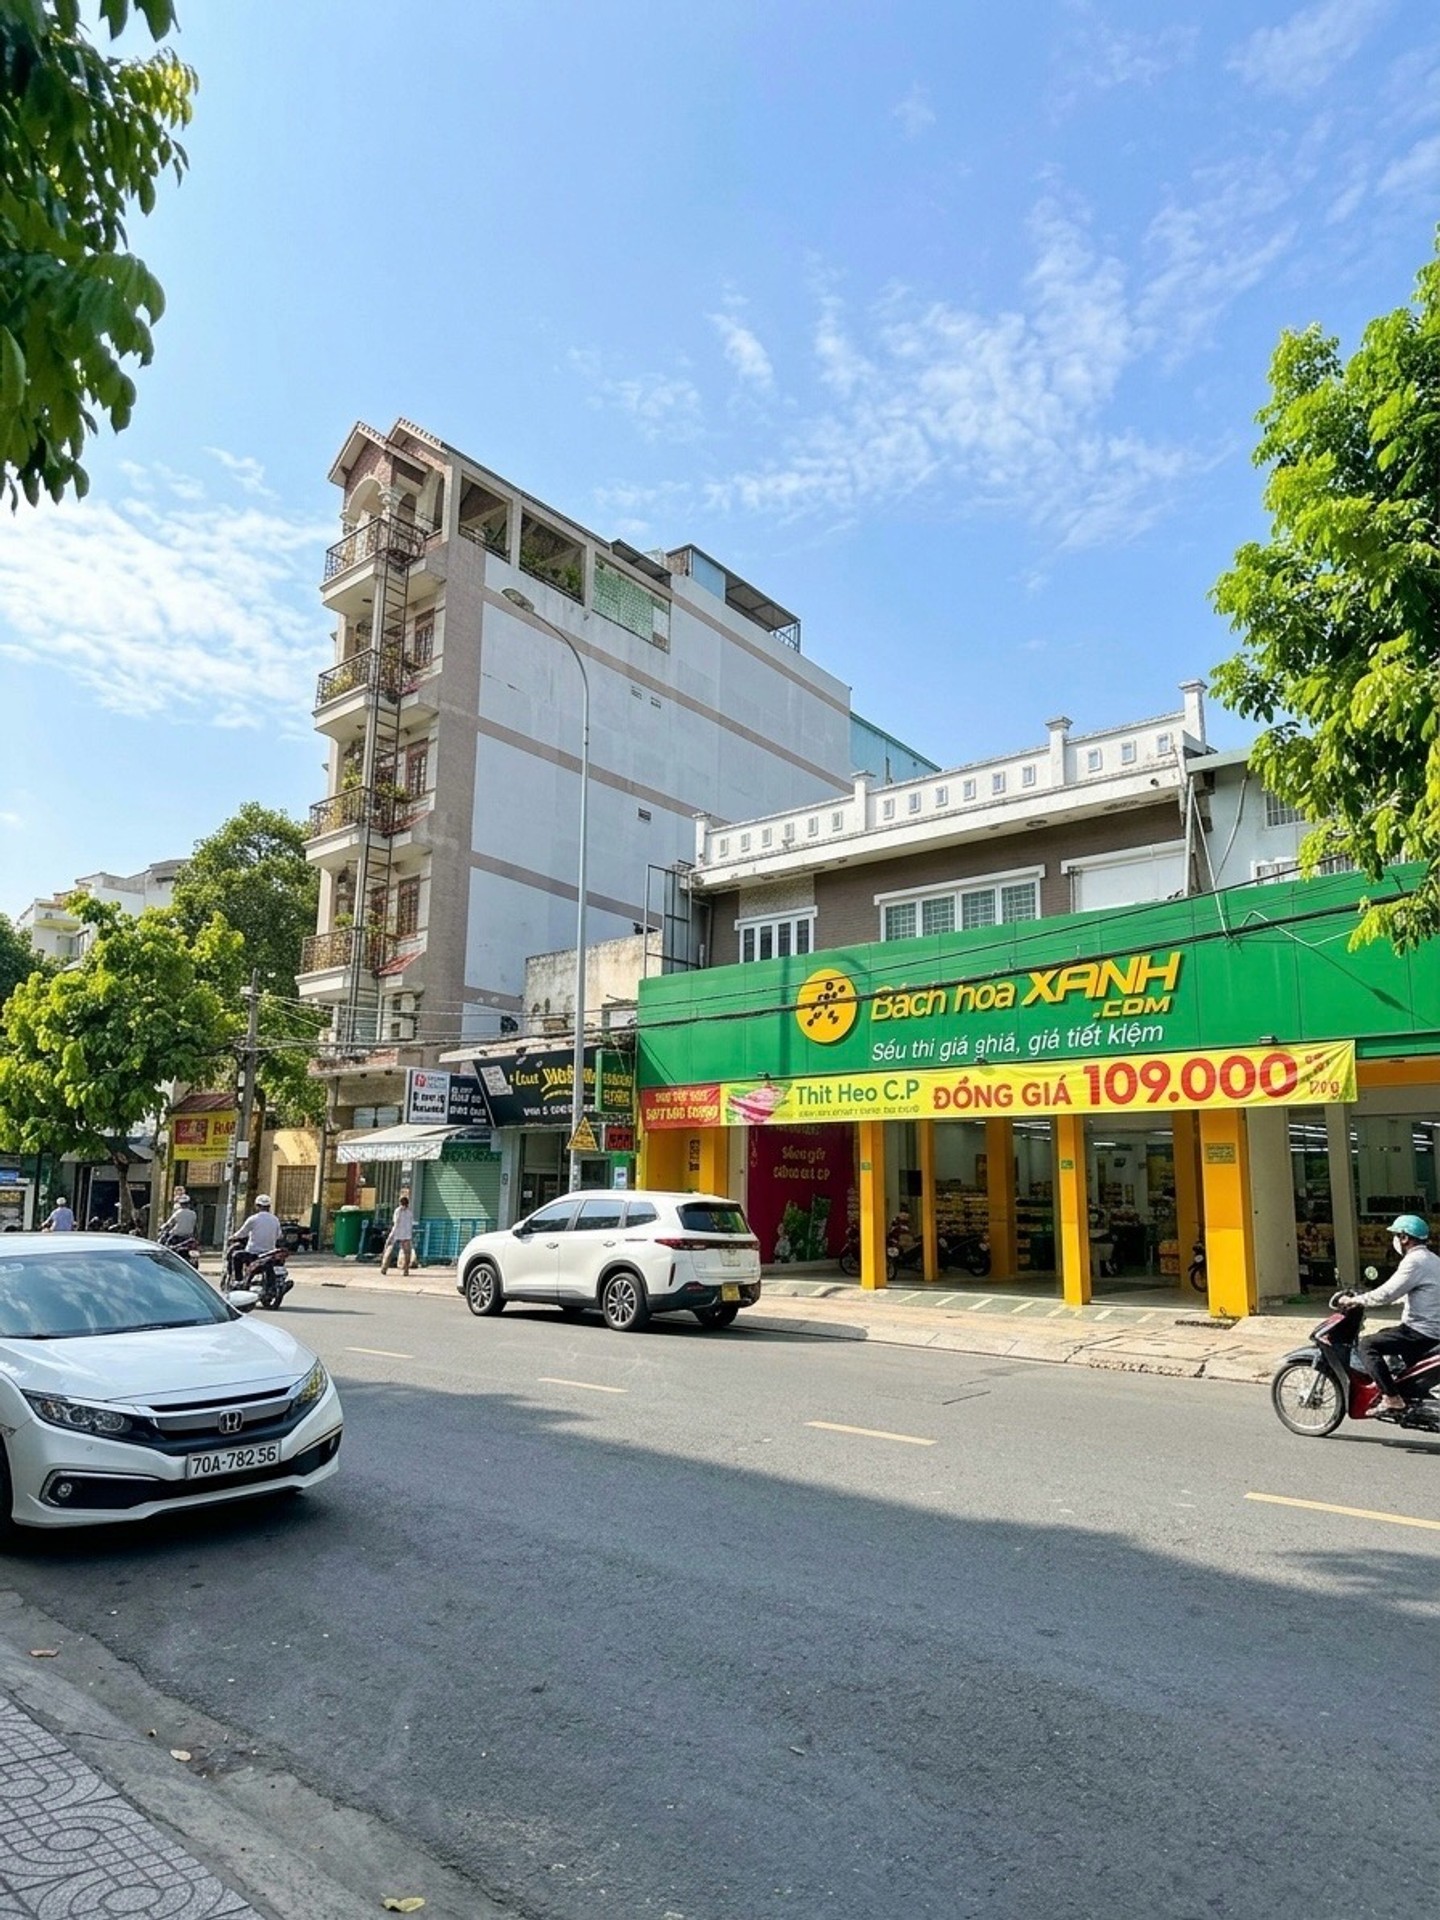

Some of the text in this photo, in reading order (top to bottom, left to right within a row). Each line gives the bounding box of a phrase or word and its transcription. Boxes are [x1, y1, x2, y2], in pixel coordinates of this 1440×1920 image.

[1021, 951, 1181, 1006] XANH
[939, 1034, 969, 1062] giá
[1066, 1022, 1103, 1048] tiết
[838, 1083, 878, 1102] Heo
[883, 1078, 920, 1101] C.P
[1021, 1074, 1073, 1107] GIÁ
[1083, 1052, 1299, 1106] 109.000
